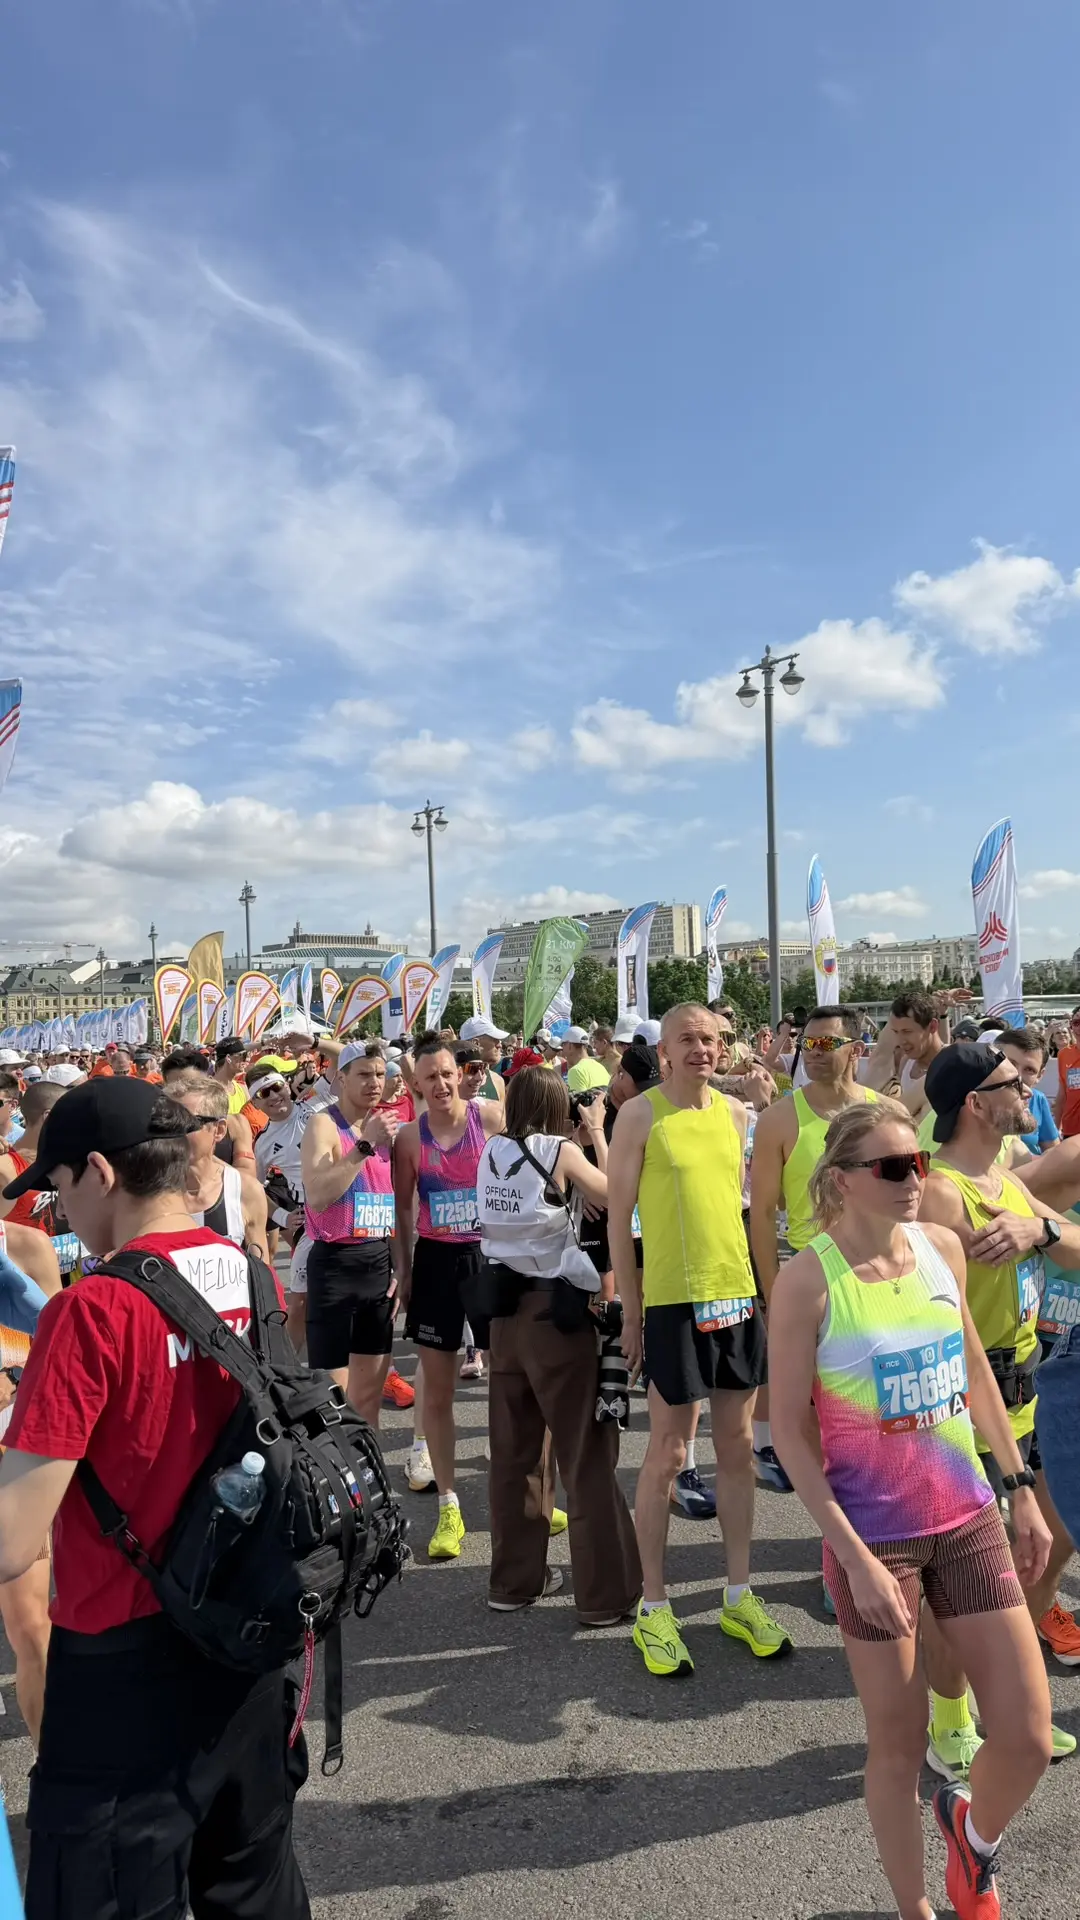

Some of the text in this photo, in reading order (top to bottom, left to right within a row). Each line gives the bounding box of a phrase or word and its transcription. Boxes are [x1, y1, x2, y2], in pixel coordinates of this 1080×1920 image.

[546, 964, 562, 974] 24
[484, 1185, 524, 1200] OFFICIAL
[484, 1197, 521, 1214] MEDIA
[357, 1204, 393, 1226] 76875
[741, 1307, 751, 1322] A
[882, 1354, 965, 1415] 75699
[915, 1401, 952, 1430] 21.1KM
[953, 1393, 966, 1416] A
